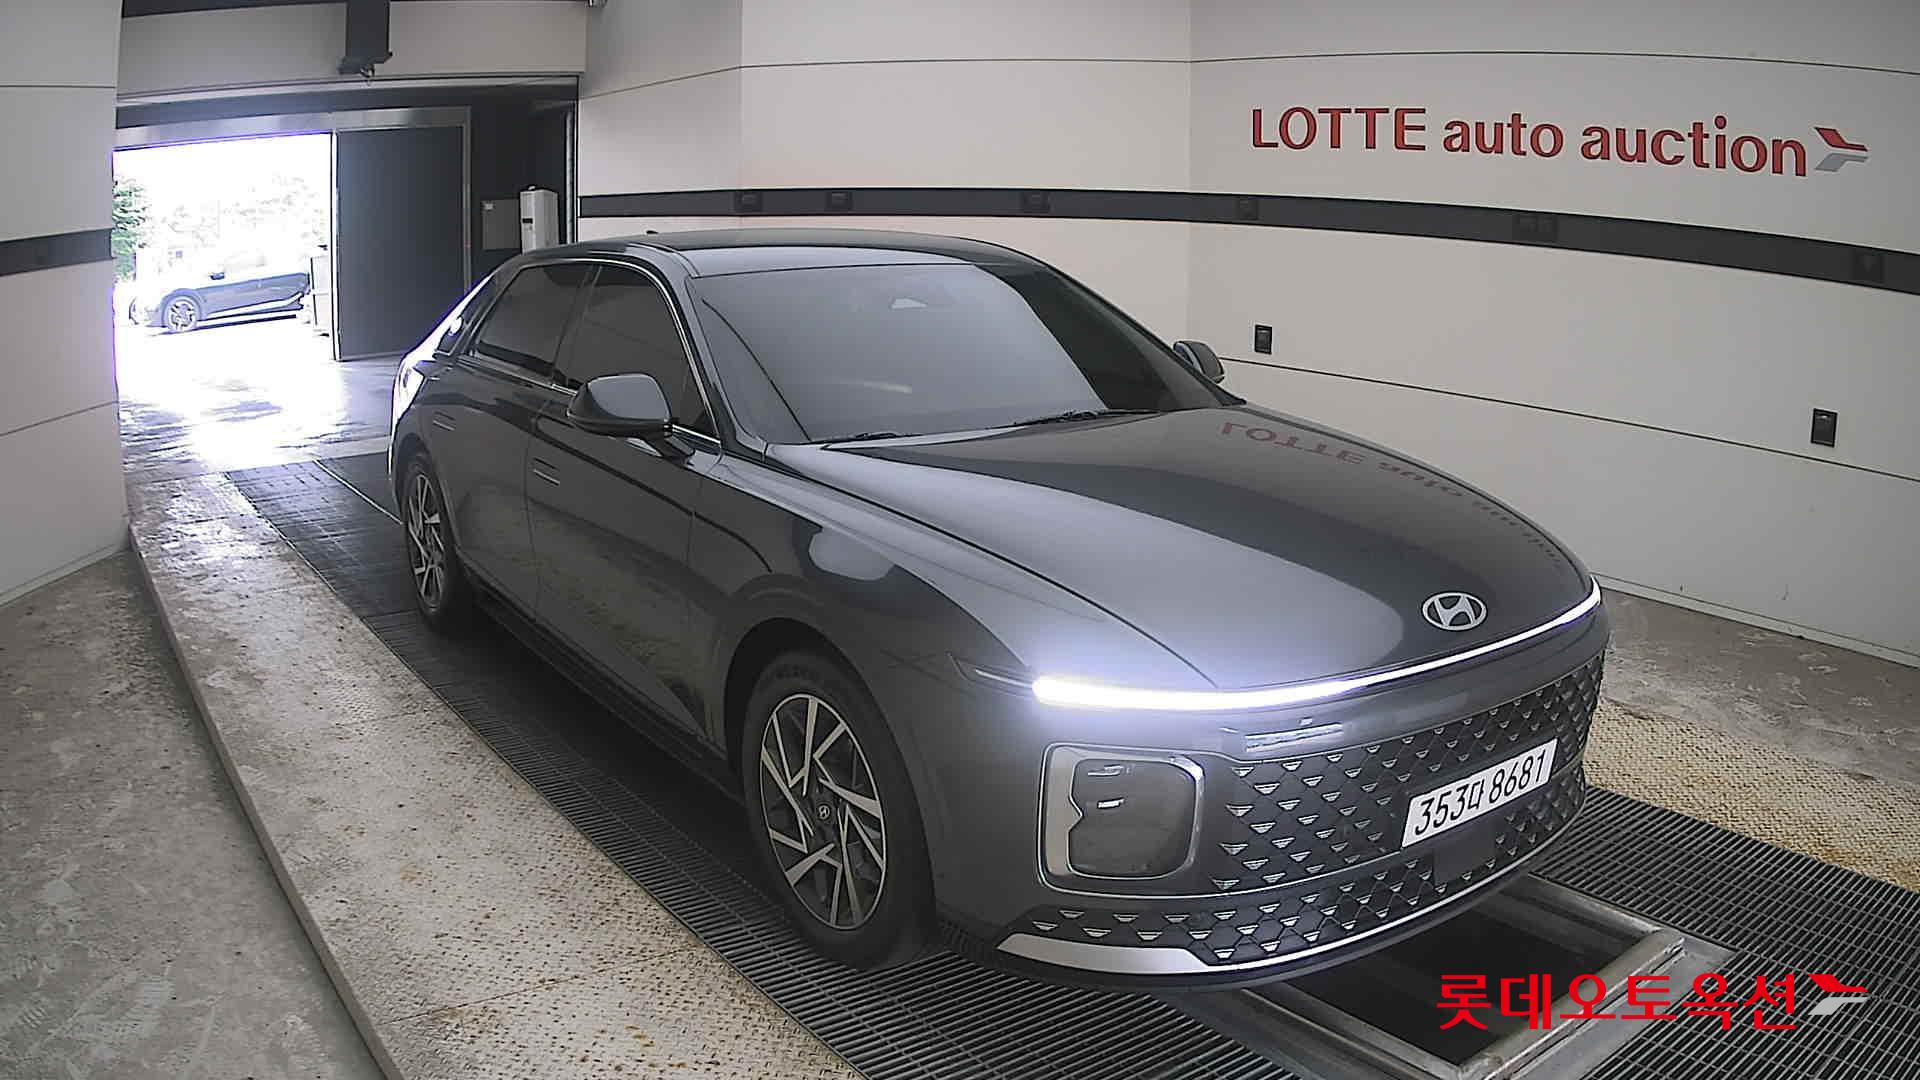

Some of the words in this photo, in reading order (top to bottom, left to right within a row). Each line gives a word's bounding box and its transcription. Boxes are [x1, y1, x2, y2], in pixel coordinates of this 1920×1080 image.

[1252, 107, 1426, 151] LOTTE
[1443, 114, 1564, 157] auto
[1581, 116, 1807, 176] auction
[1414, 779, 1485, 835] 353다
[1489, 749, 1546, 803] 8681
